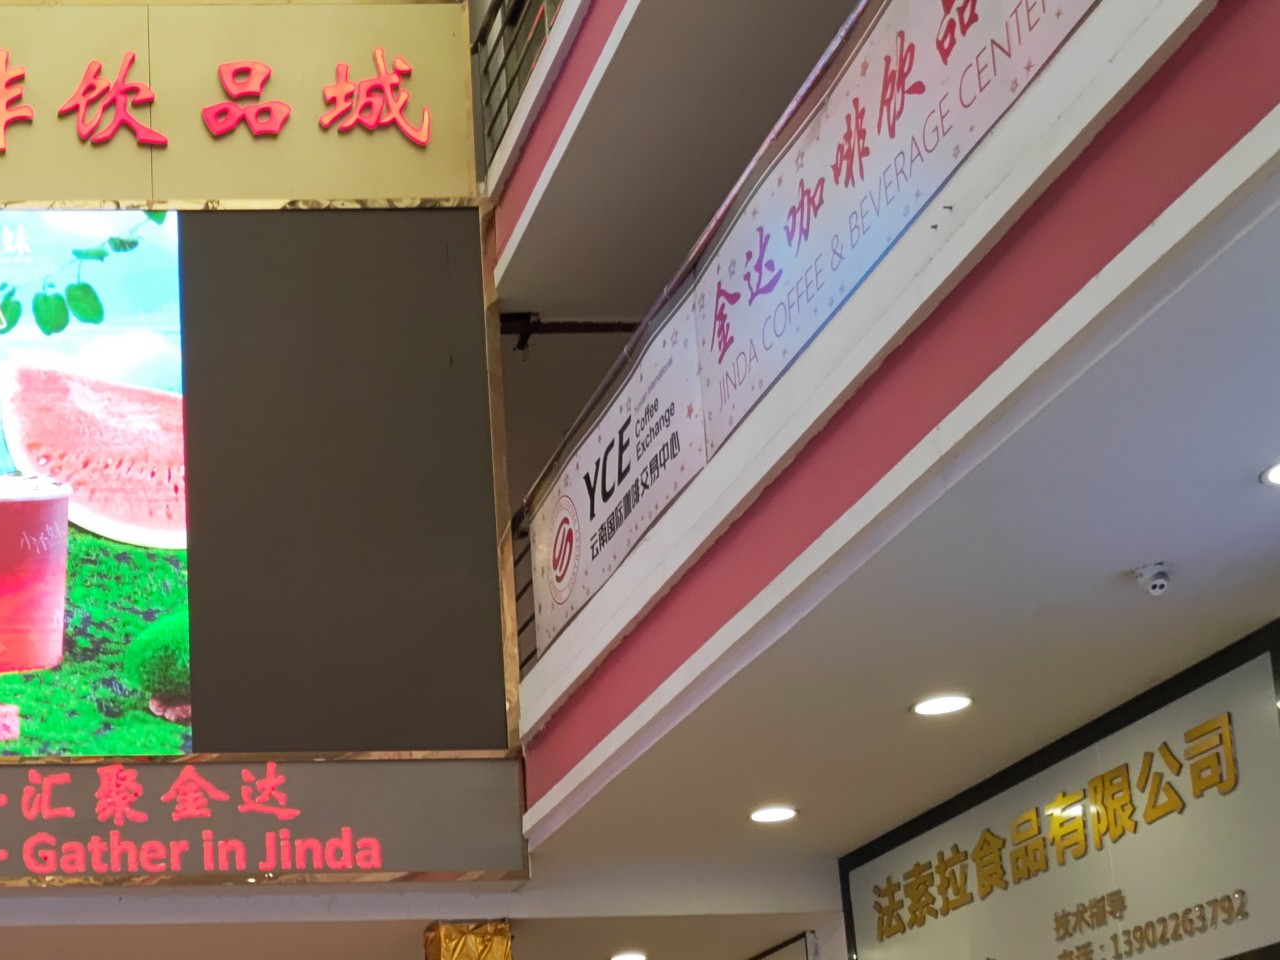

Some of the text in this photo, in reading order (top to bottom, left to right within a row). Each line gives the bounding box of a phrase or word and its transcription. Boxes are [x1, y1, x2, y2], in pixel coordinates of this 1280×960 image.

[718, 0, 1046, 412] JINDA COFFEE & BEVERAGE CENTE
[635, 398, 659, 438] Coffee
[635, 402, 676, 461] Exchange
[582, 414, 632, 521] YCE
[590, 430, 681, 561] 云南国际咖啡交易中心
[23, 830, 190, 874] Gather
[202, 828, 247, 871] in
[259, 827, 383, 870] Jinda
[873, 711, 1240, 942] 法索拉食品有限公司
[1054, 889, 1127, 942] 技术指导
